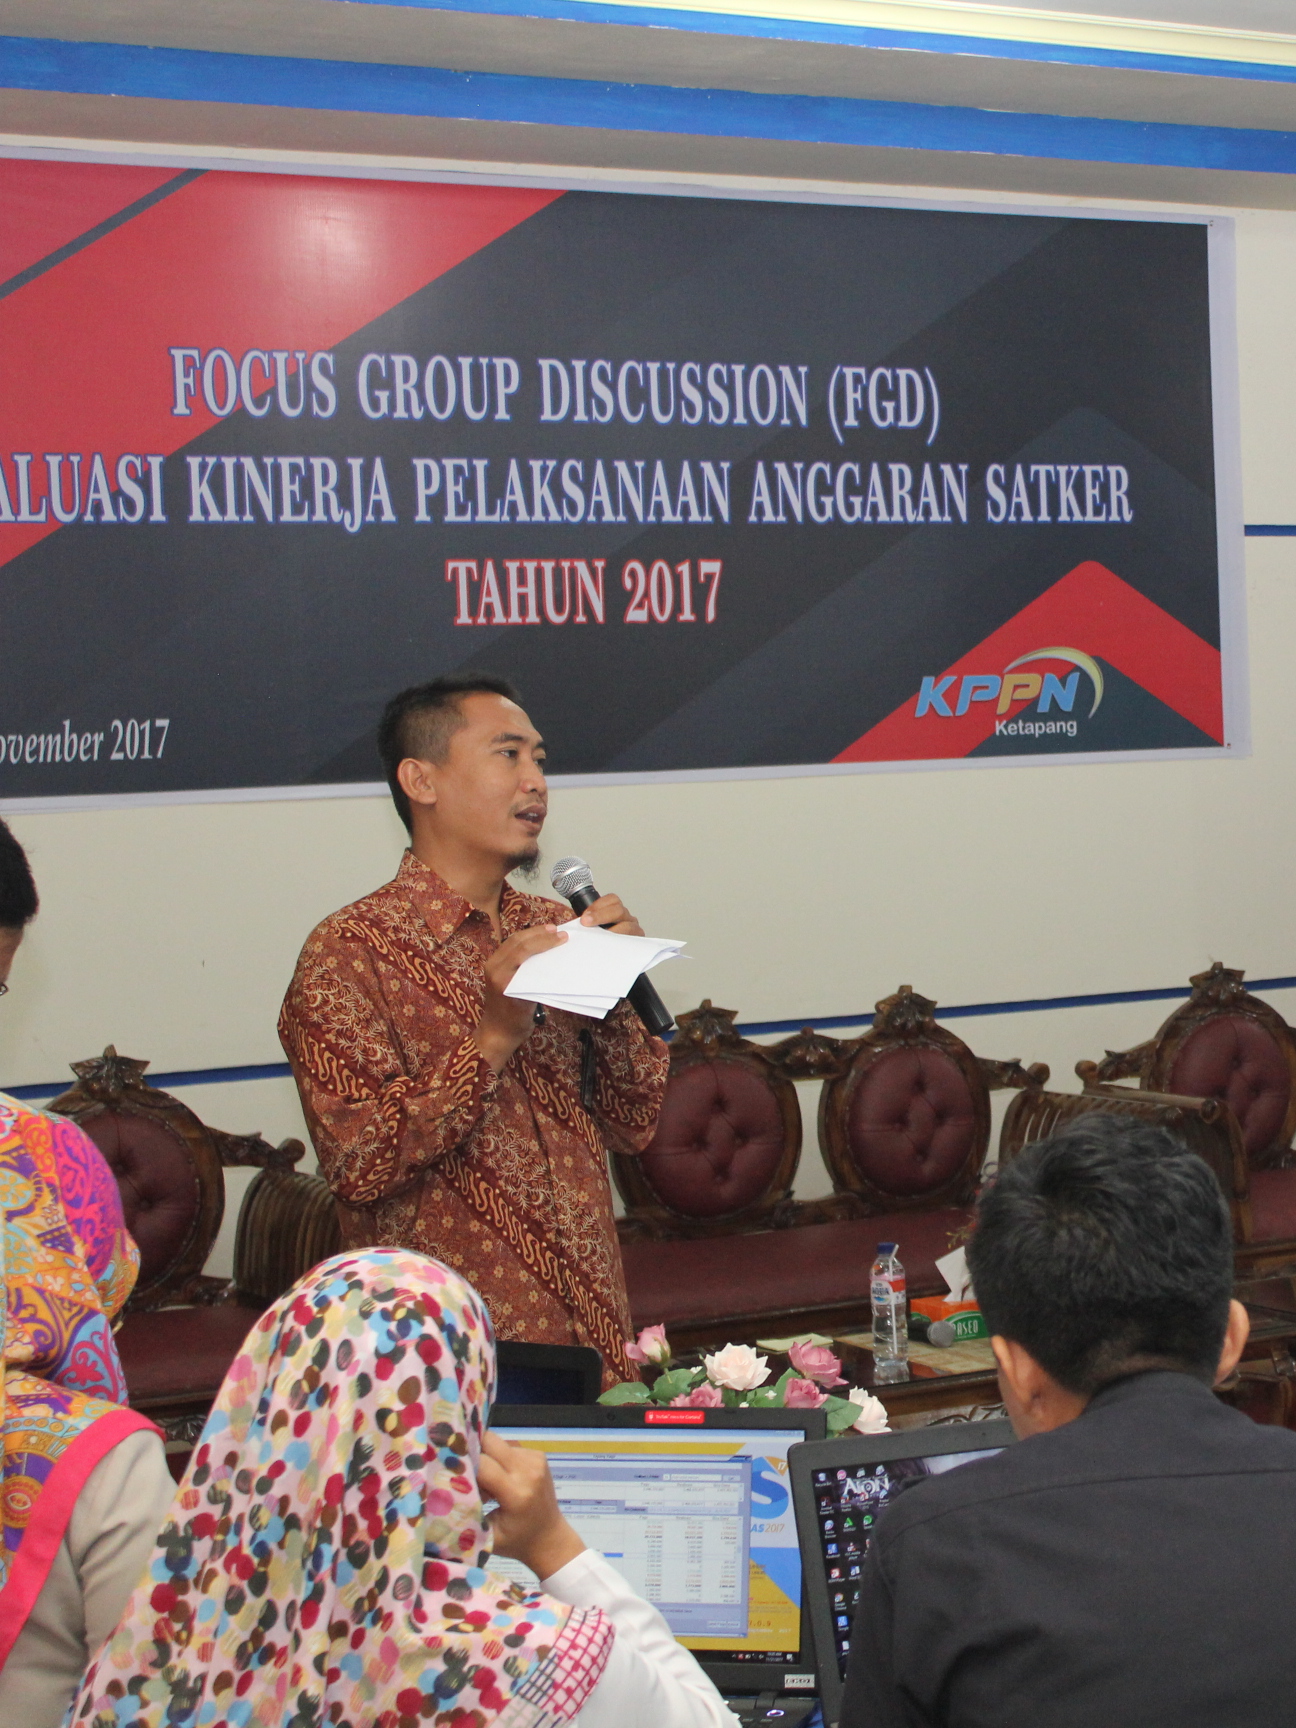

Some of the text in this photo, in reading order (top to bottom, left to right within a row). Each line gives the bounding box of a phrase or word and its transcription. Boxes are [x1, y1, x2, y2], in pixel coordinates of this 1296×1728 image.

[169, 347, 939, 445] FOCUS GROUP DISCUSSION (FGD)
[186, 455, 397, 533] KINERJA
[413, 457, 731, 524] PELAKSANAAN
[748, 461, 969, 524] ANGGARAN
[986, 463, 1133, 523] SATKER
[445, 558, 722, 625] TAHUN 2017
[914, 672, 1080, 719] KPPN
[110, 717, 170, 761] 2017
[995, 719, 1078, 738] Ketapang
